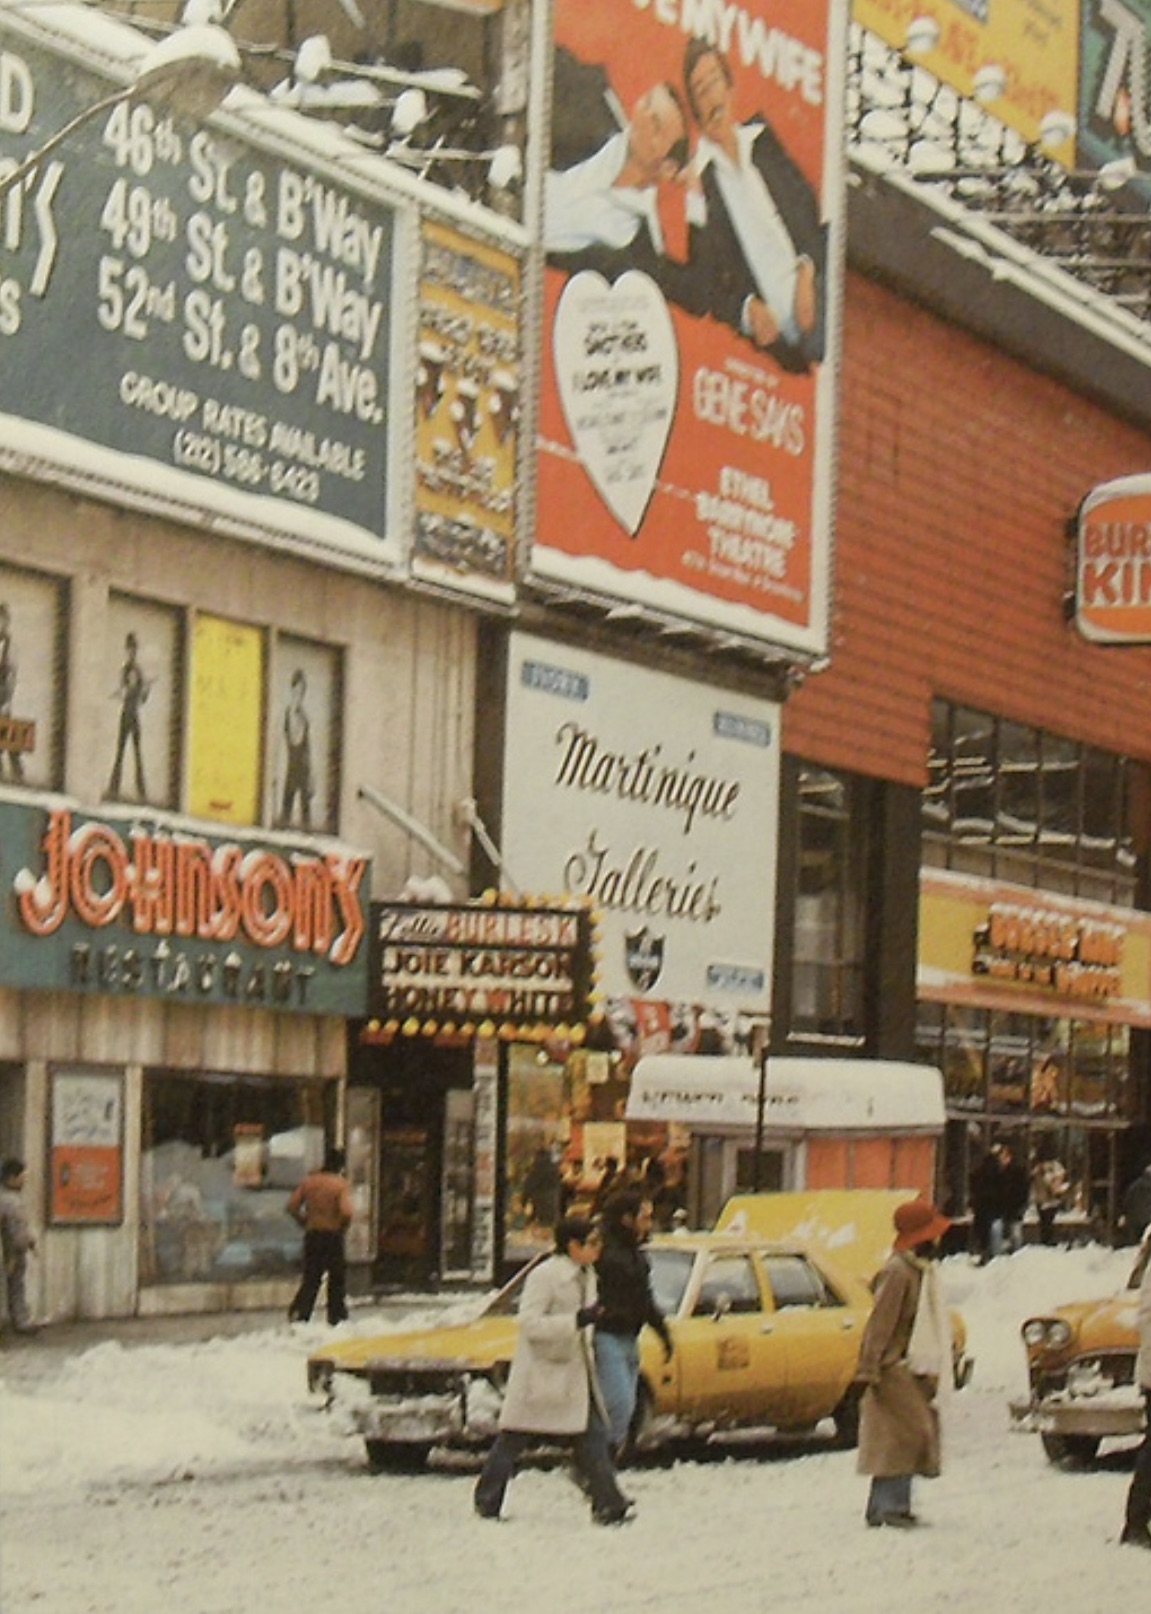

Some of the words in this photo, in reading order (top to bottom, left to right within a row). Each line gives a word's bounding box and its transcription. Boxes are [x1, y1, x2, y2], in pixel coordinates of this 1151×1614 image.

[738, 9, 823, 106] WIFE
[104, 100, 183, 176] 46th
[245, 169, 267, 229] &
[102, 178, 178, 259] 49th
[243, 247, 265, 306] &
[97, 255, 177, 342] 52nd
[183, 288, 233, 371] St.
[239, 323, 261, 381] &
[274, 323, 320, 394] 8th
[315, 341, 384, 426] Ave.
[119, 370, 199, 423] GROUP
[202, 398, 269, 449] RATES
[554, 719, 742, 837] Martinique
[564, 827, 723, 925] Galleries
